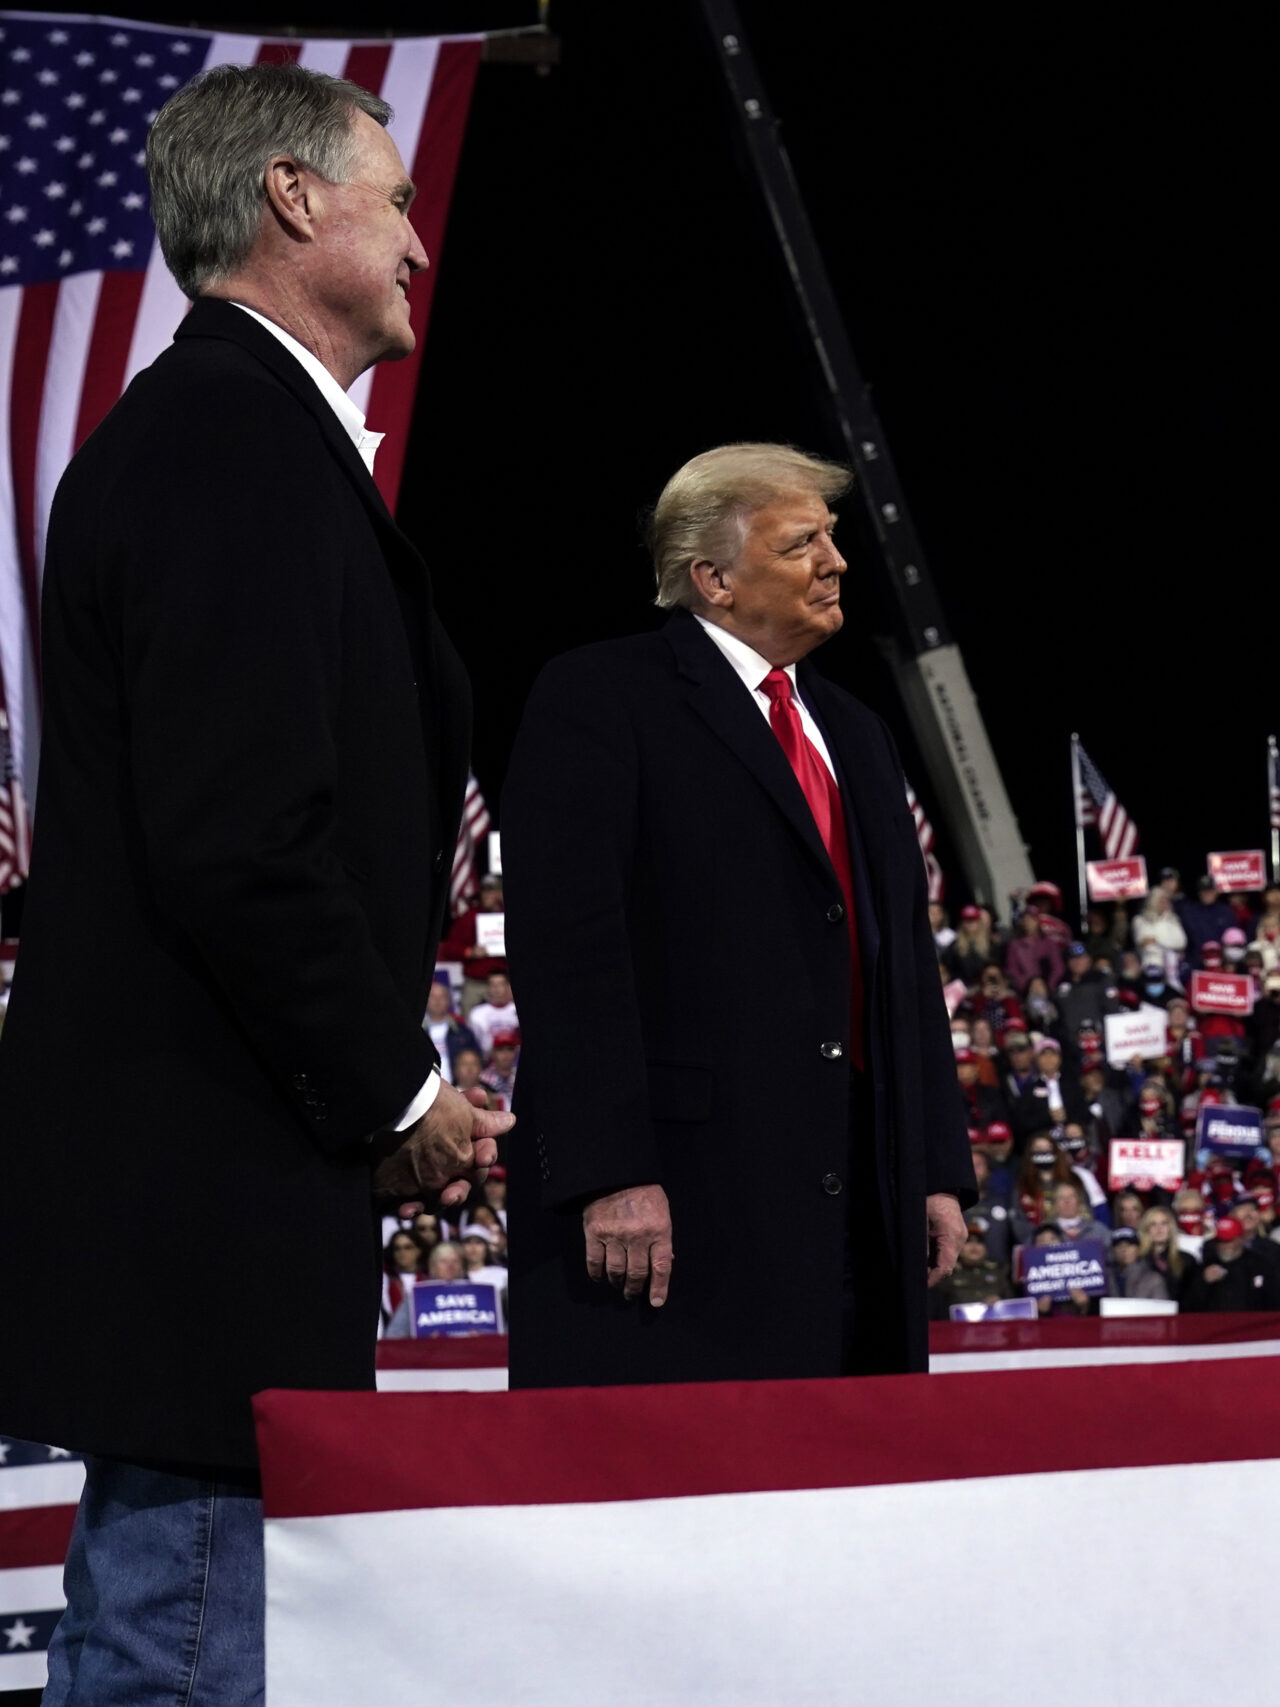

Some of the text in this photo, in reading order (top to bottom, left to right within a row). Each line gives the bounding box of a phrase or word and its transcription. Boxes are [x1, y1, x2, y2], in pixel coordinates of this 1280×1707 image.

[1117, 1147, 1177, 1160] KELLY
[1027, 1259, 1104, 1281] AMERICA
[434, 1294, 478, 1310] SAVE
